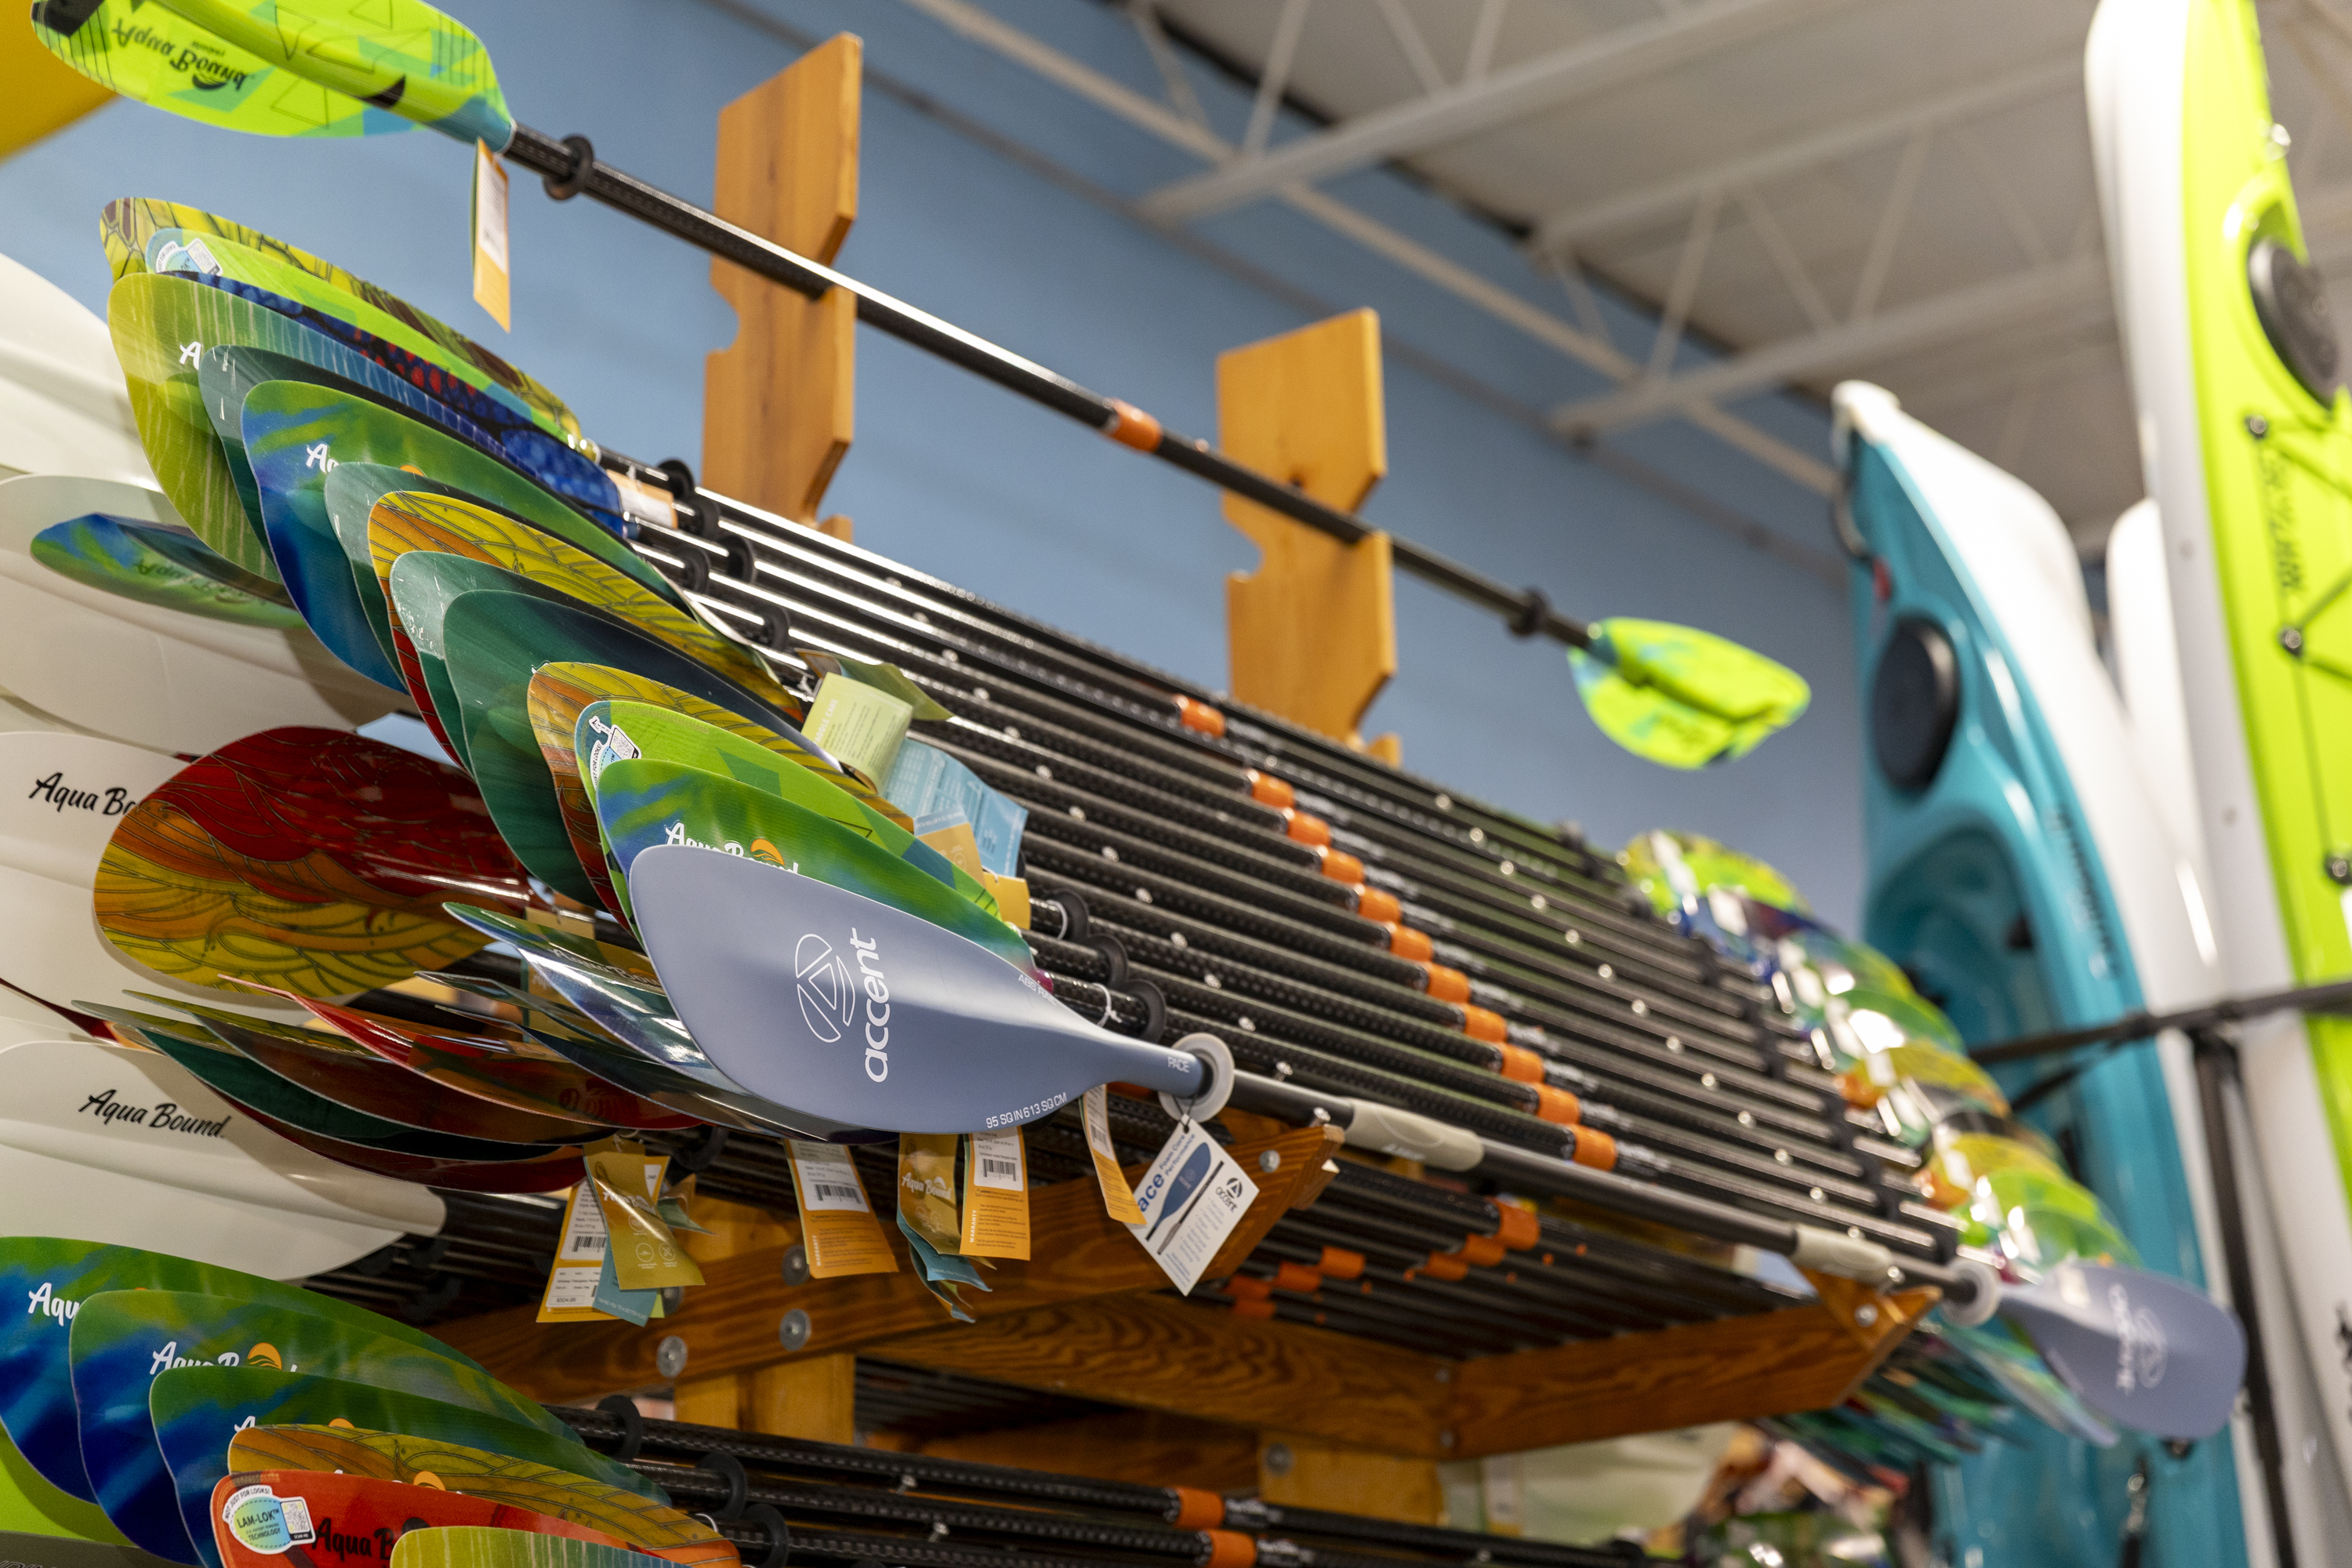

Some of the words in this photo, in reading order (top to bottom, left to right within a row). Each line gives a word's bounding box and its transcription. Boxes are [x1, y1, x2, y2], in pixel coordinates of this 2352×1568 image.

[825, 697, 840, 718] CARE
[28, 771, 100, 813] Aqua
[850, 927, 891, 1083] accent
[1018, 974, 1037, 993] ABS
[1037, 986, 1057, 1005] RAIL
[1167, 1056, 1191, 1073] PACE
[78, 1089, 149, 1126] Aqua
[985, 1116, 999, 1129] 95
[1000, 1112, 1013, 1125] SQ
[1024, 1103, 1041, 1118] 613
[1040, 1098, 1054, 1112] SQ
[1054, 1092, 1067, 1106] CM
[902, 1171, 925, 1193] Aqua
[924, 1178, 953, 1200] Bound
[1136, 1171, 1165, 1213] ace
[1214, 1186, 1238, 1213] accent
[812, 1235, 822, 1267] WARRANTY
[27, 1282, 79, 1327] Aqu
[230, 1494, 241, 1507] JUST
[240, 1490, 251, 1498] FOR
[250, 1486, 270, 1495] LOOKS!
[248, 1529, 281, 1541] TECHNOLOGY
[311, 1517, 372, 1562] Aqua
